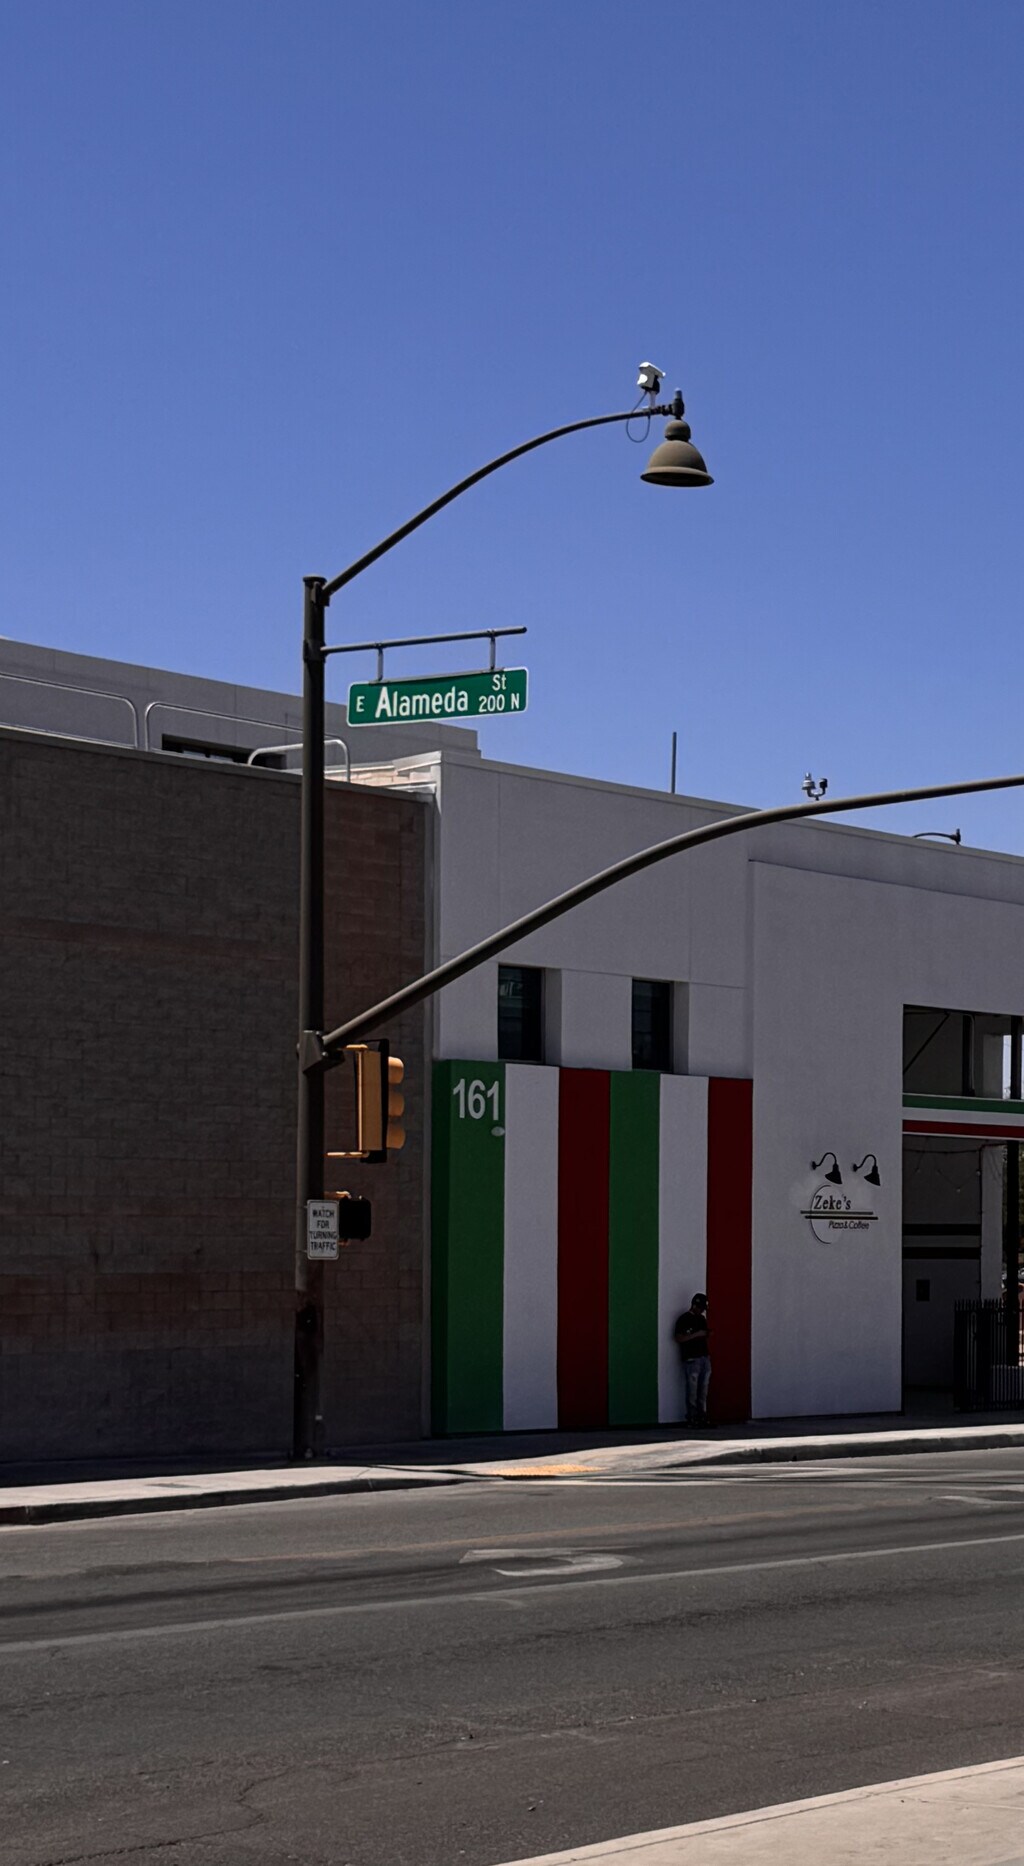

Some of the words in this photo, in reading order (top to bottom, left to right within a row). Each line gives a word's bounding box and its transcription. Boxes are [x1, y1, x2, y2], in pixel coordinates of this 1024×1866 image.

[492, 674, 507, 691] St
[356, 696, 365, 713] E
[375, 686, 468, 718] Alameda
[478, 693, 505, 713] 200
[510, 693, 520, 710] N
[452, 1078, 500, 1121] 161
[813, 1195, 852, 1211] Zeke's
[316, 1220, 330, 1229] FOR
[310, 1241, 336, 1250] TRAFFIC
